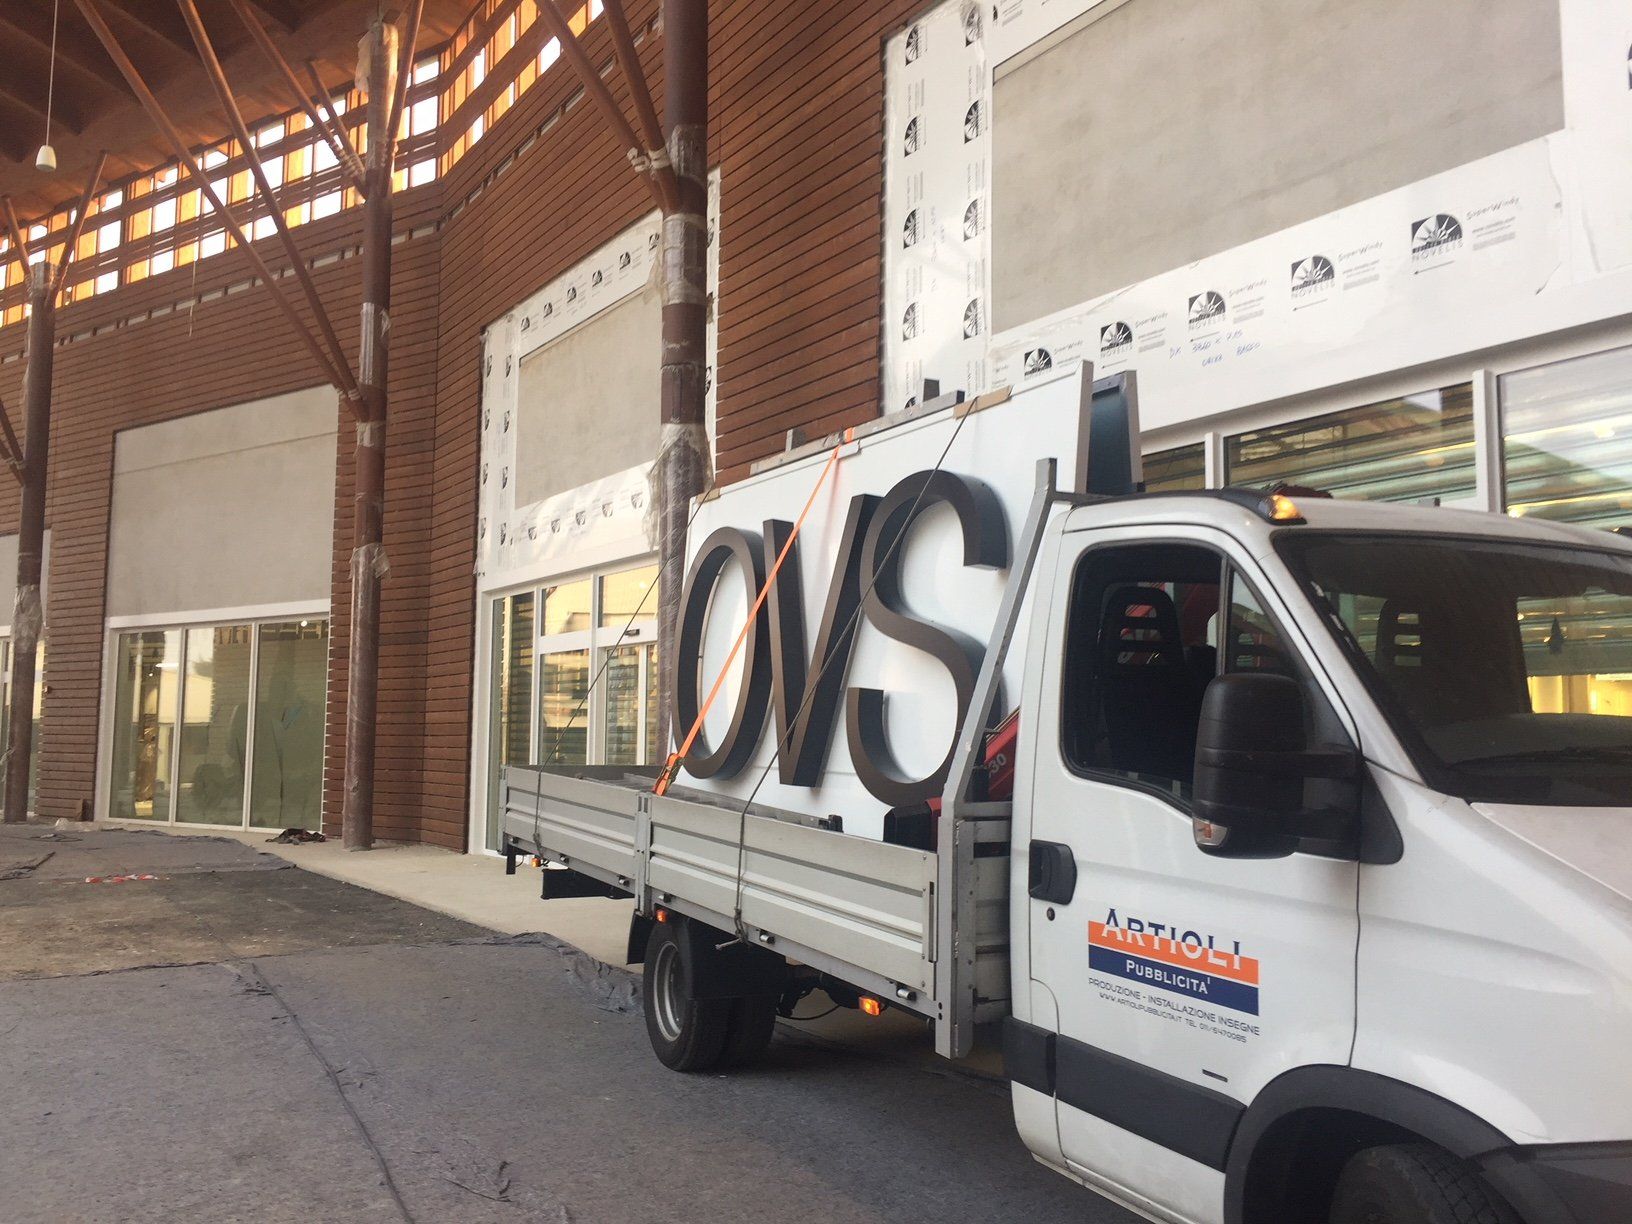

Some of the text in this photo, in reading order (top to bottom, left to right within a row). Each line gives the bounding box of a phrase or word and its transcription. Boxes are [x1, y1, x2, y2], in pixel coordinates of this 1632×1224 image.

[672, 469, 1008, 807] OVS
[988, 753, 1007, 779] 30
[1102, 907, 1241, 971] ARTIOLI
[1088, 977, 1141, 1000] PRODUZIONE
[1148, 995, 1216, 1023] INSTALLAZIONE
[1218, 1015, 1260, 1036] INSEGNE
